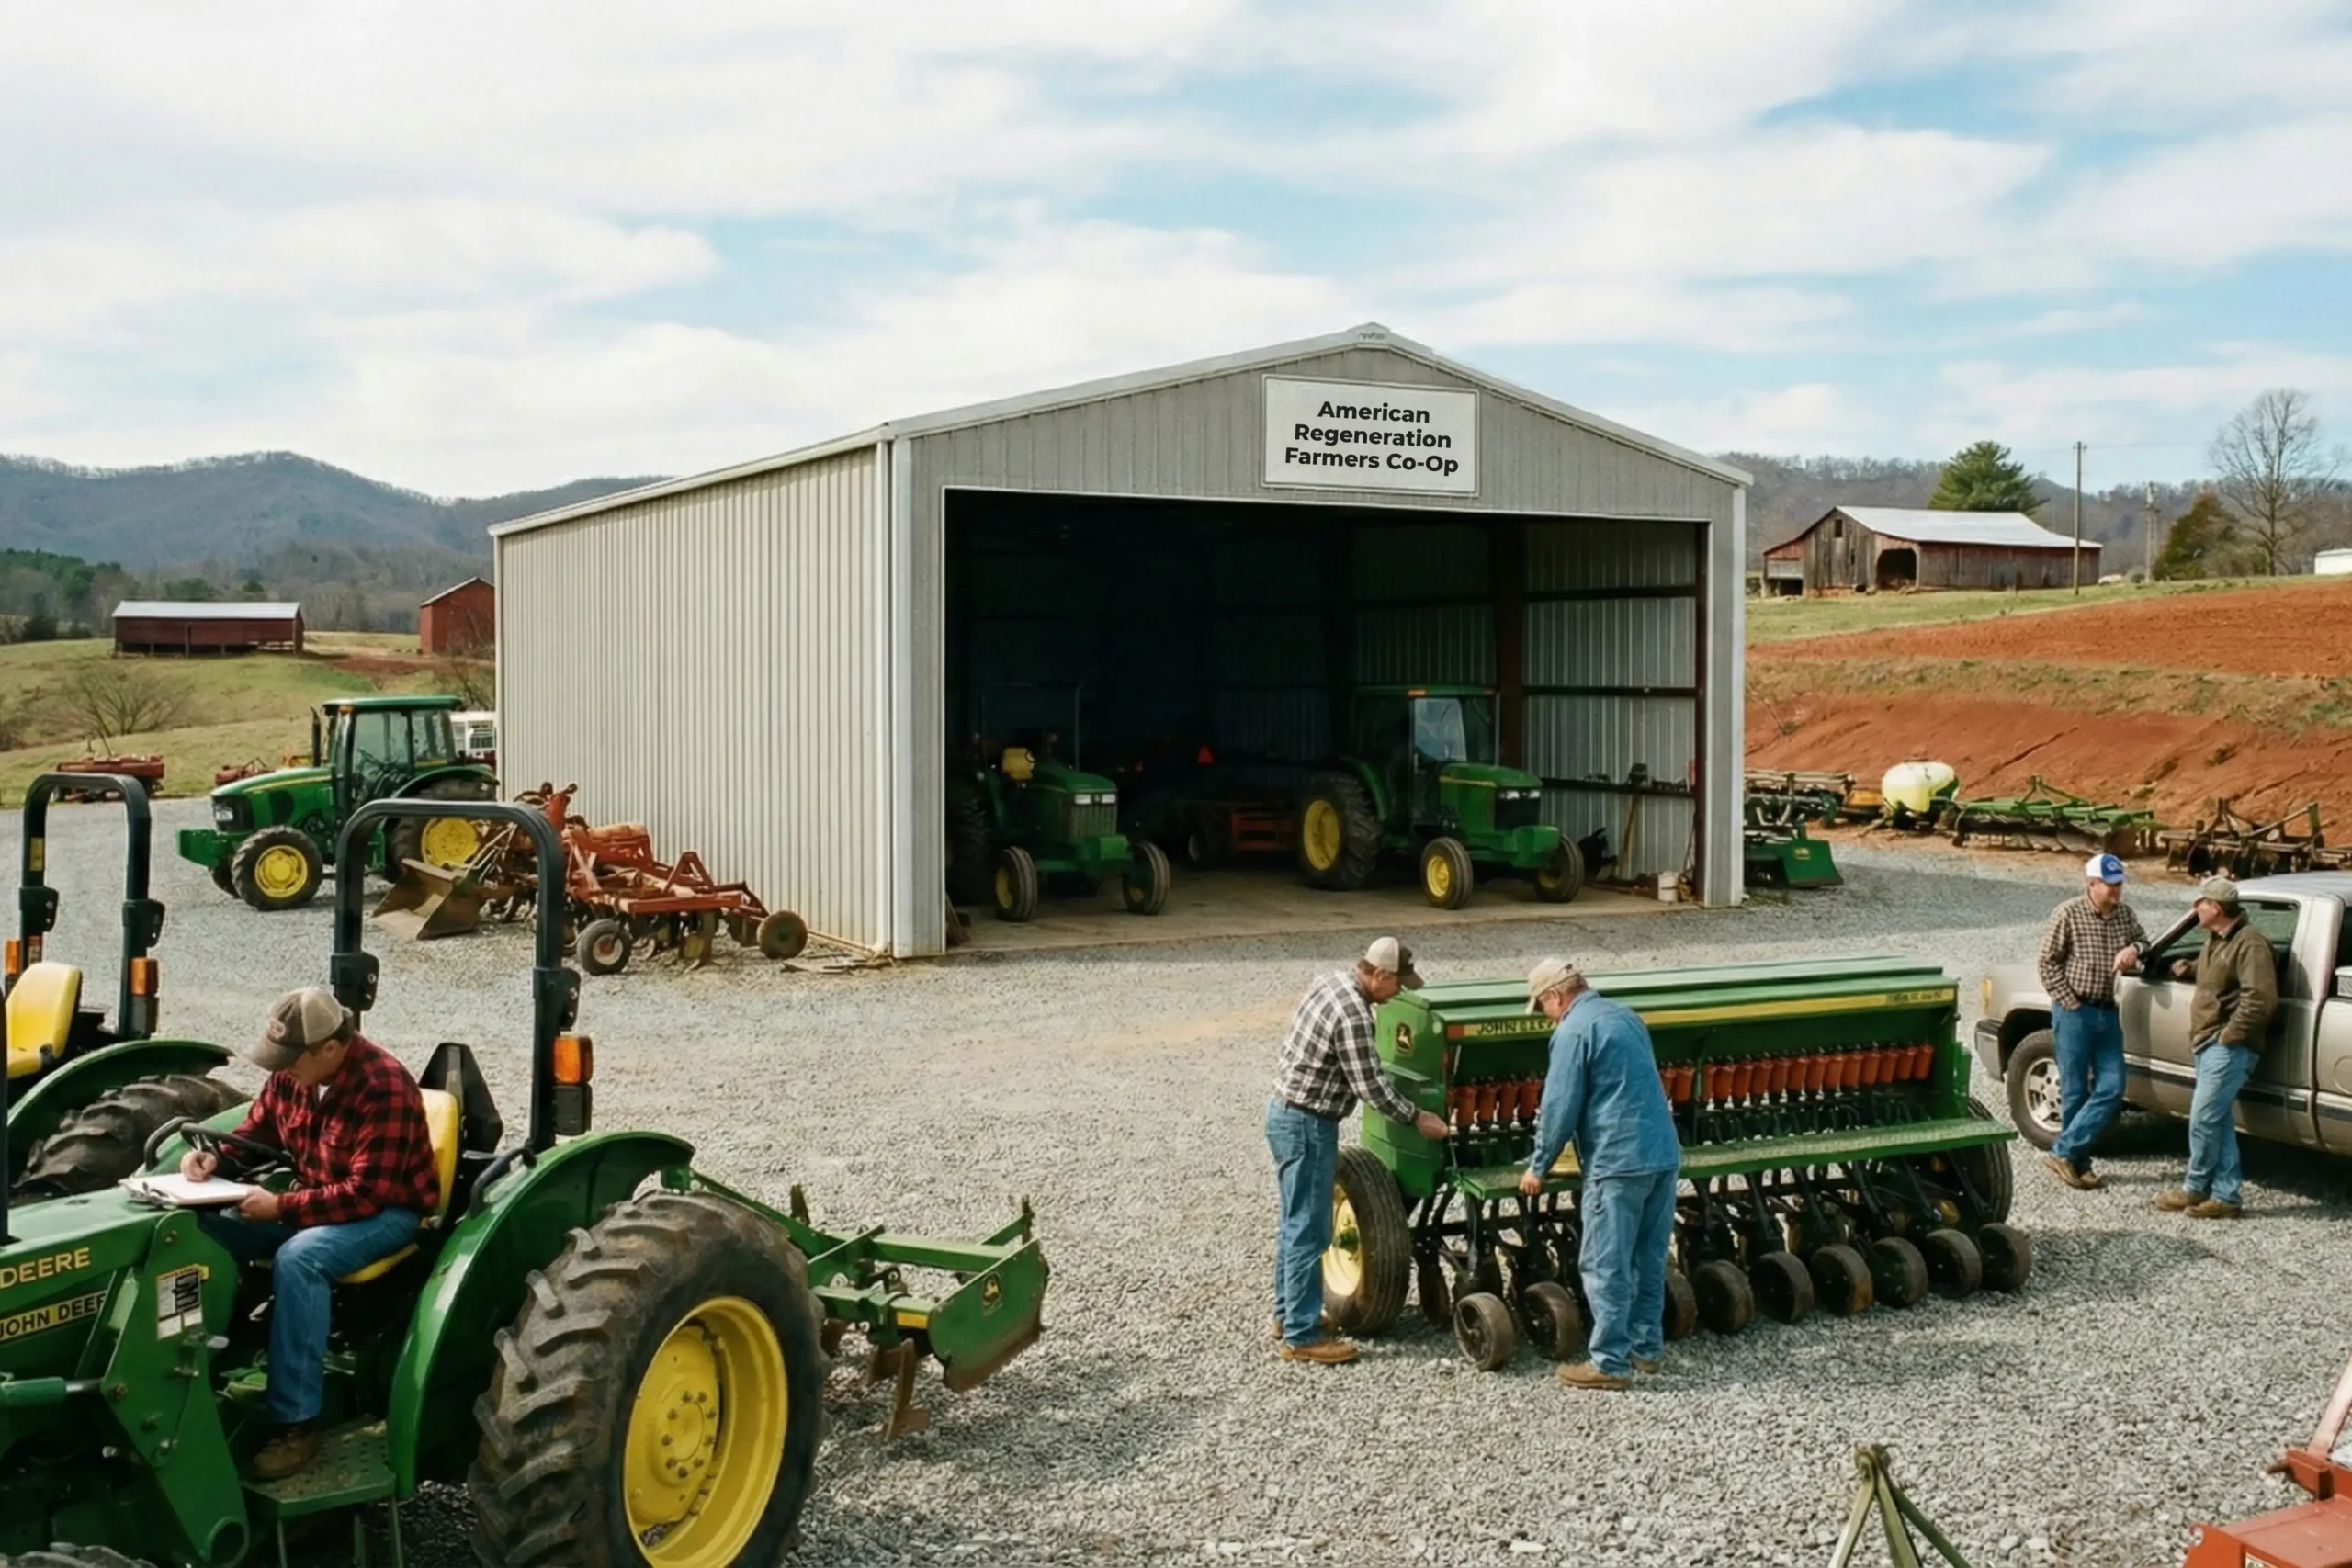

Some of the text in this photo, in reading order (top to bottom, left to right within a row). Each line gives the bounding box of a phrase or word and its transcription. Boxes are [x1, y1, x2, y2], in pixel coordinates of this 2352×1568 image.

[1317, 401, 1430, 423] American
[1295, 423, 1452, 448] Regeneration
[1285, 447, 1459, 477] Farmers Co-Op
[0, 1247, 90, 1289] DEERE
